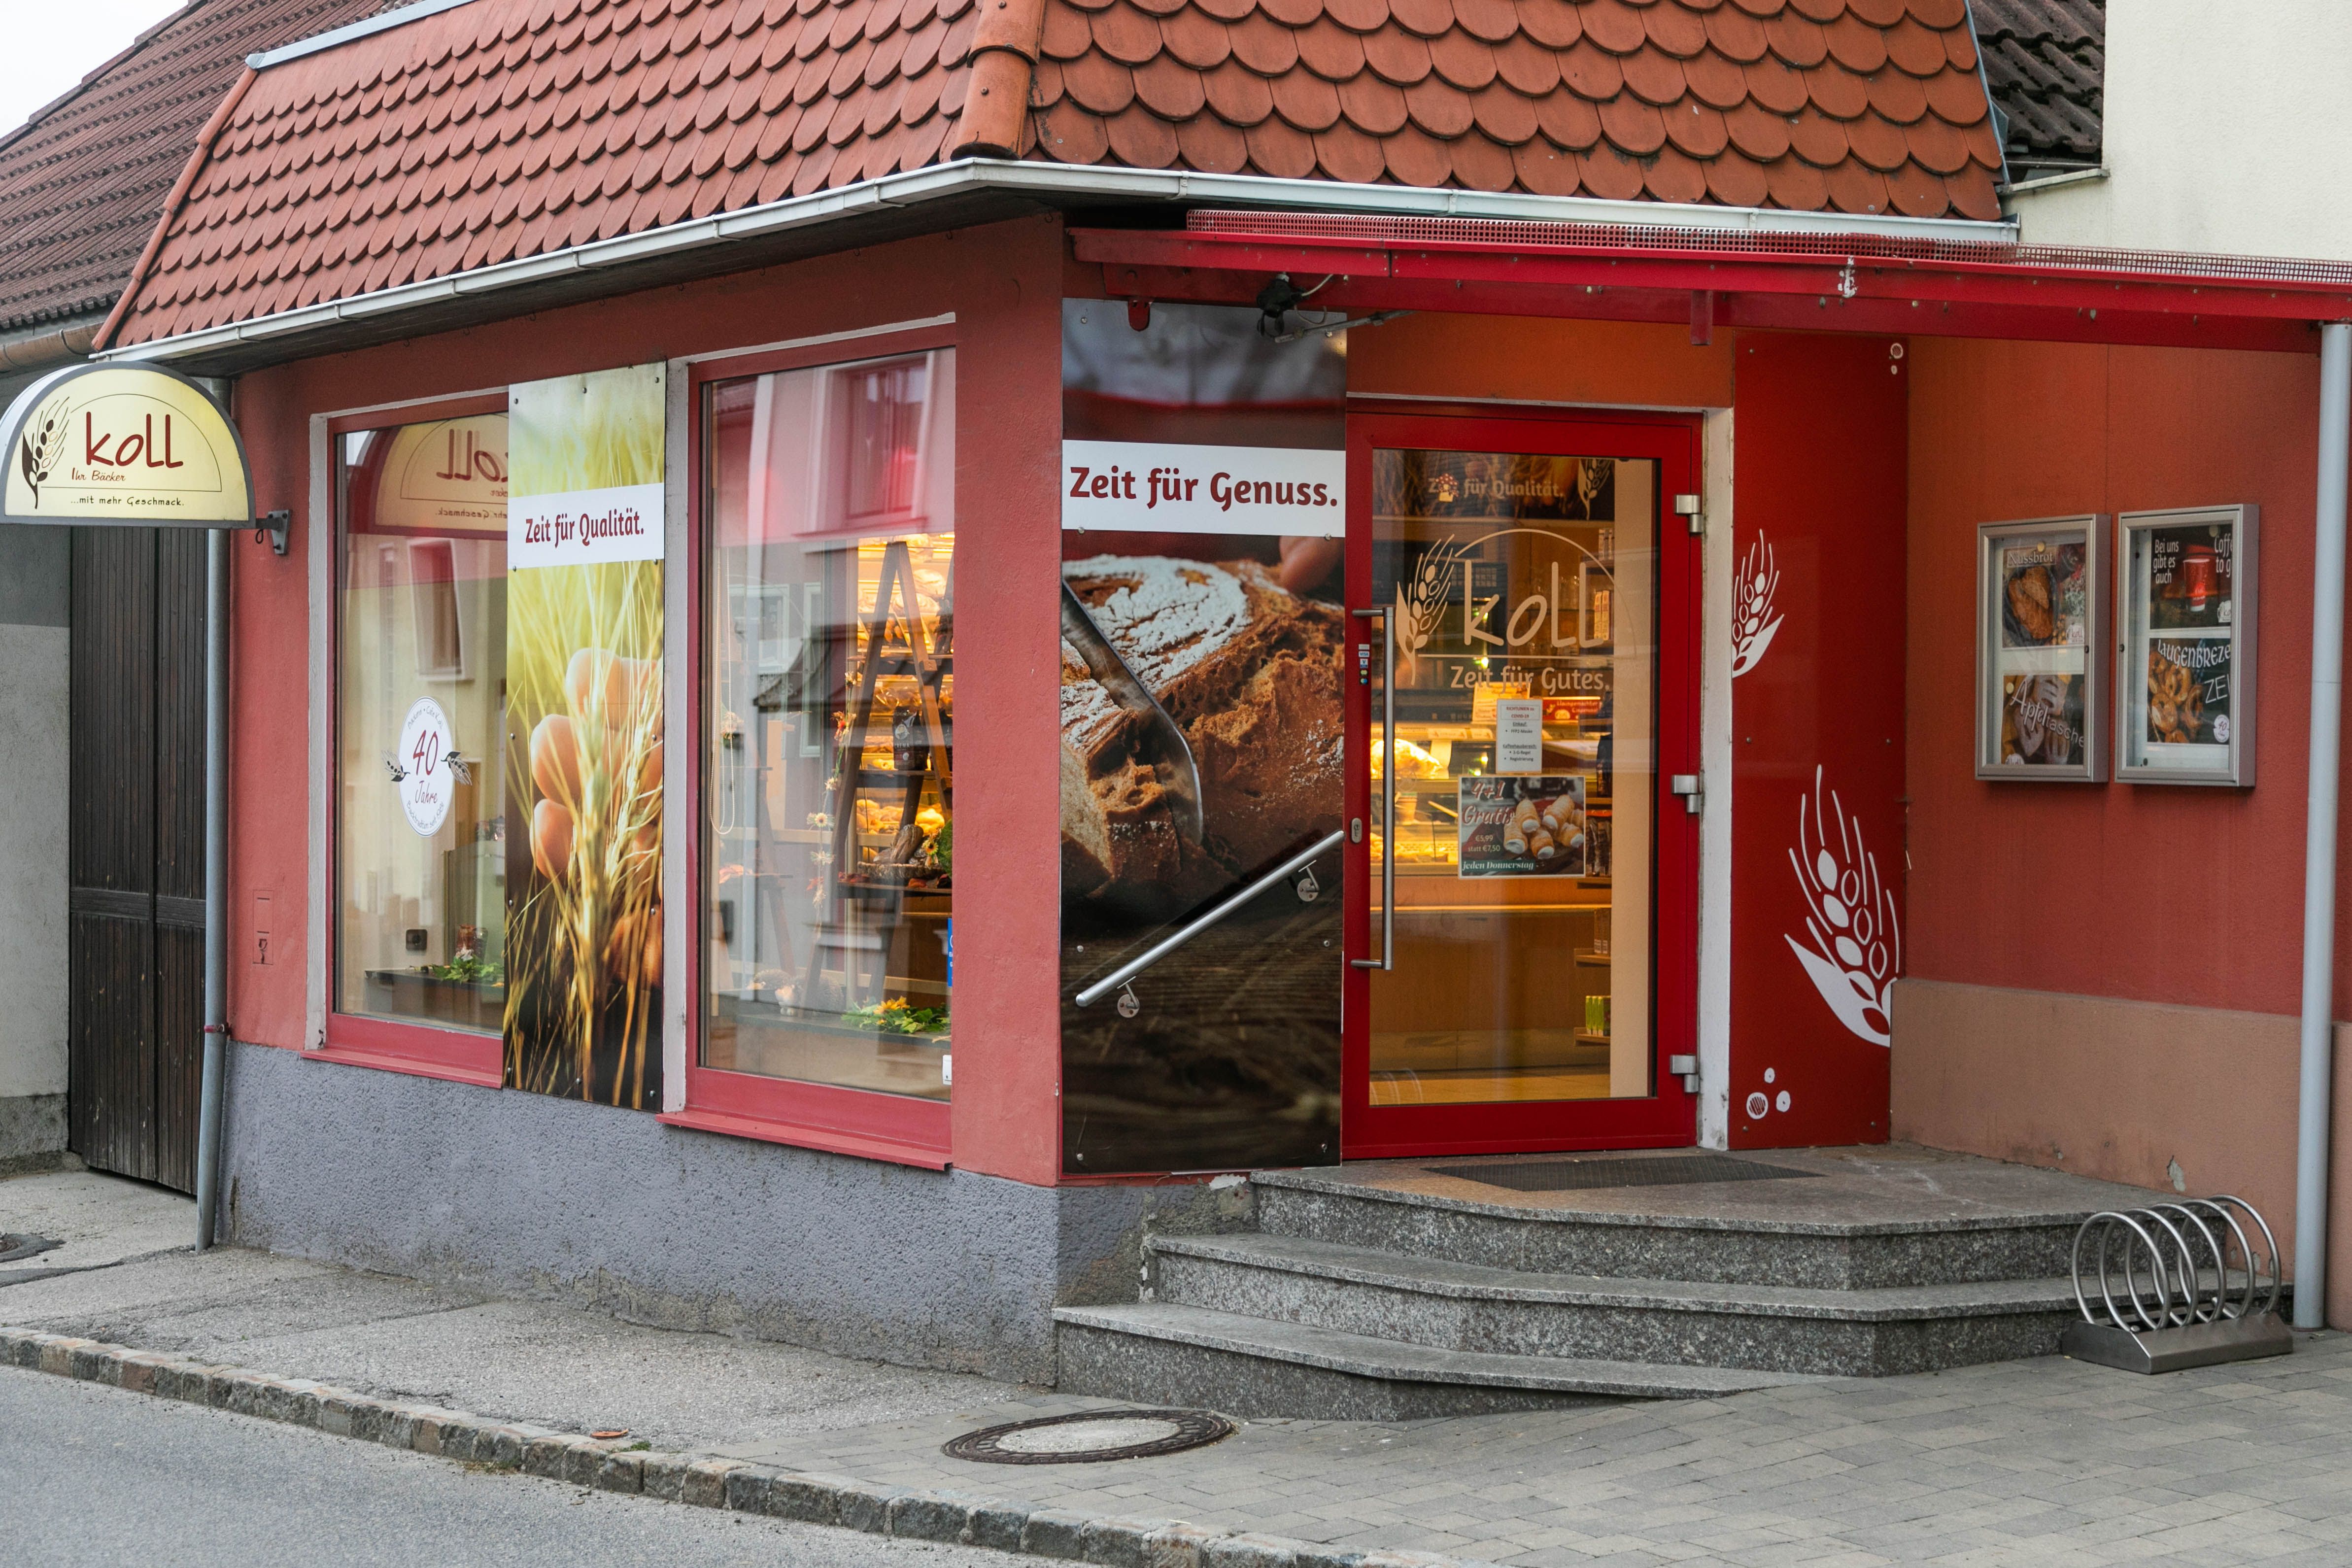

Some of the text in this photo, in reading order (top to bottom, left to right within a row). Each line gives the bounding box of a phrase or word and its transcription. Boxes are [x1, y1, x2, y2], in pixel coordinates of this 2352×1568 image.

[71, 468, 126, 481] Ihr Bäcker
[1070, 465, 1337, 512] Zeit für Genuss.
[1464, 478, 1488, 498] für
[1492, 479, 1565, 499] Qualität.
[99, 496, 122, 504] mehr
[127, 497, 184, 507] Geschmack.
[526, 507, 644, 548] Zeit für Qualität.
[2155, 539, 2179, 553] Bei uns
[2009, 551, 2052, 565] Nussbrot
[2153, 554, 2176, 572] gibt es
[2216, 557, 2231, 578] to g
[2155, 570, 2172, 583] auch
[1451, 665, 1493, 688] Zeit
[1500, 666, 1534, 694] für
[1541, 667, 1610, 695] Gutes.
[413, 729, 438, 776] 40
[415, 780, 438, 804] Jahre
[1471, 780, 1505, 800] 4+1
[1462, 805, 1515, 825] Gratis
[1483, 845, 1500, 853] €7,50
[1463, 861, 1534, 871] jeden Donnerstag
